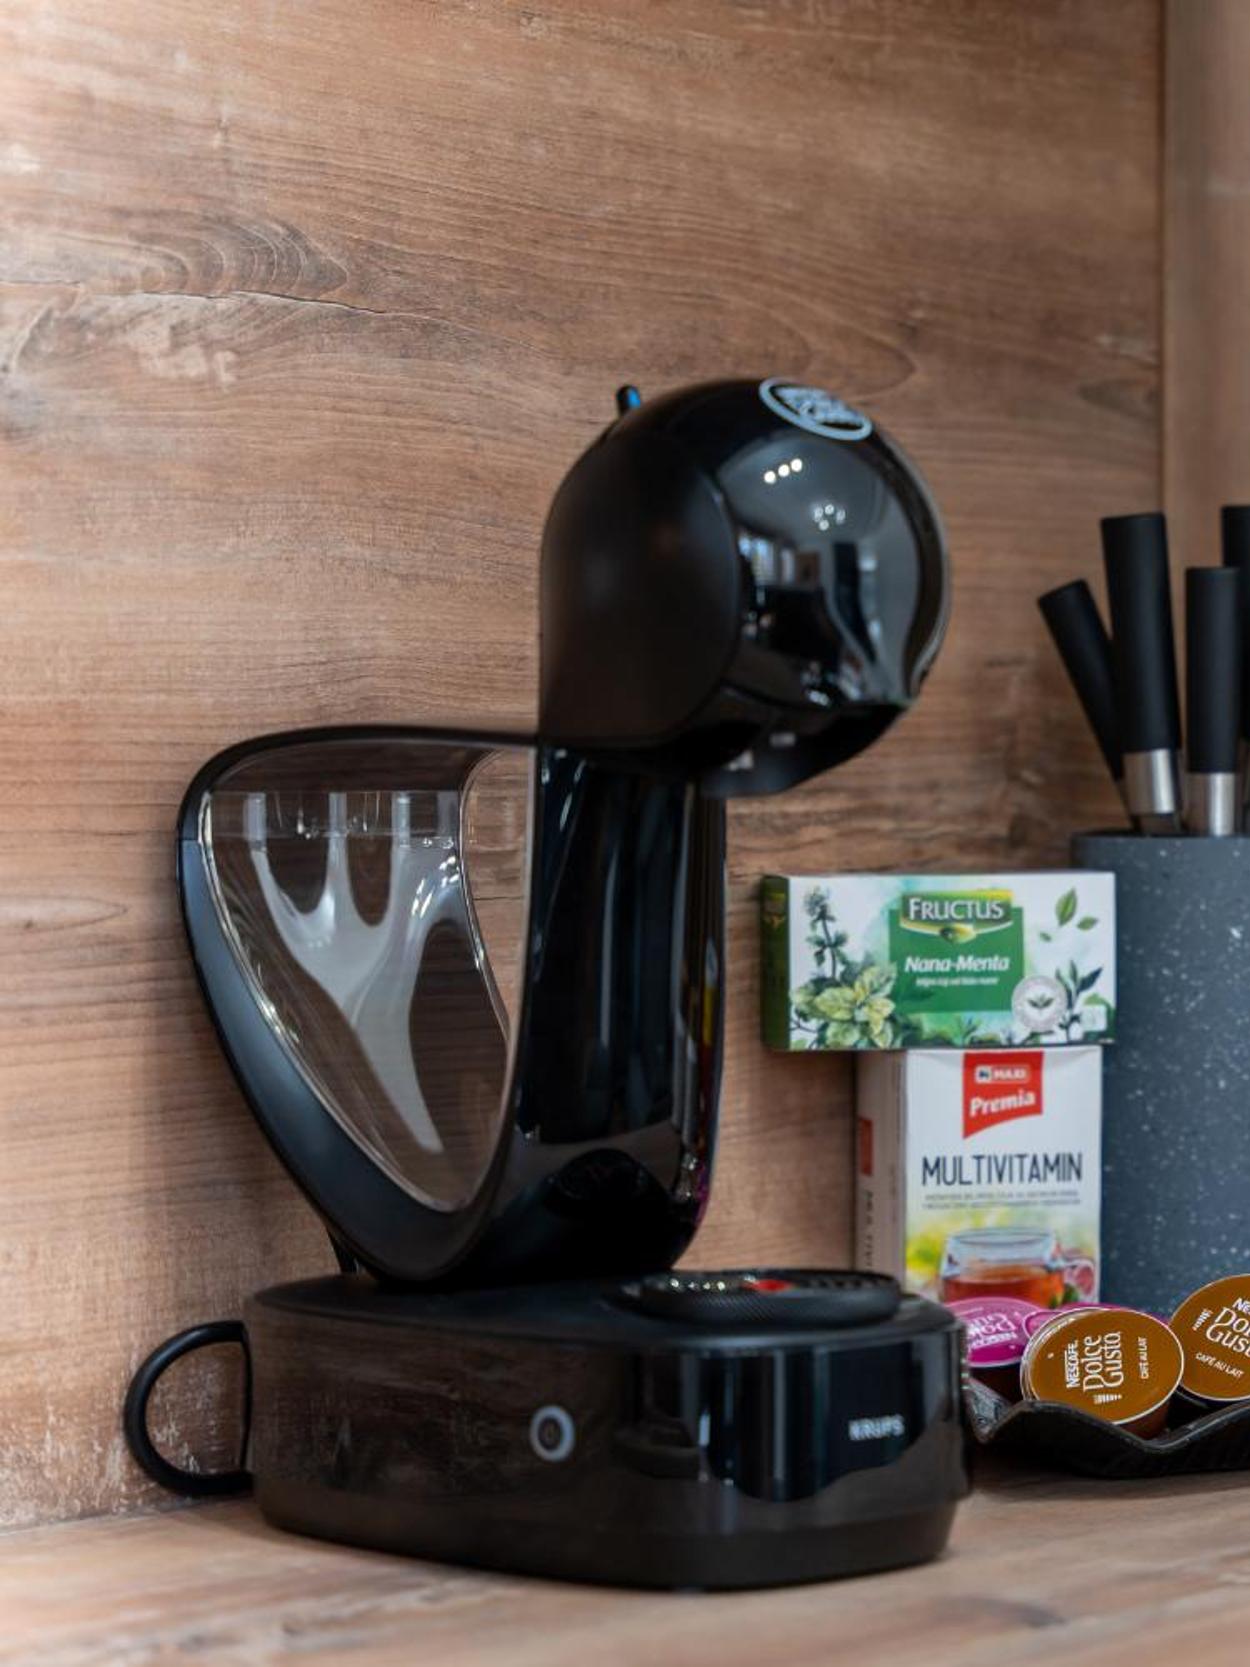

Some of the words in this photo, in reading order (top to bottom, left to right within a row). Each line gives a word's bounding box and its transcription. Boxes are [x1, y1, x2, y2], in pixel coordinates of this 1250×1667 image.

[909, 897, 1004, 920] FRUCTUS
[970, 1088, 1036, 1118] Premia
[922, 1152, 1083, 1186] MULTIVITAMIN
[1081, 1335, 1103, 1392] Dolce
[1100, 1331, 1124, 1388] Gusto
